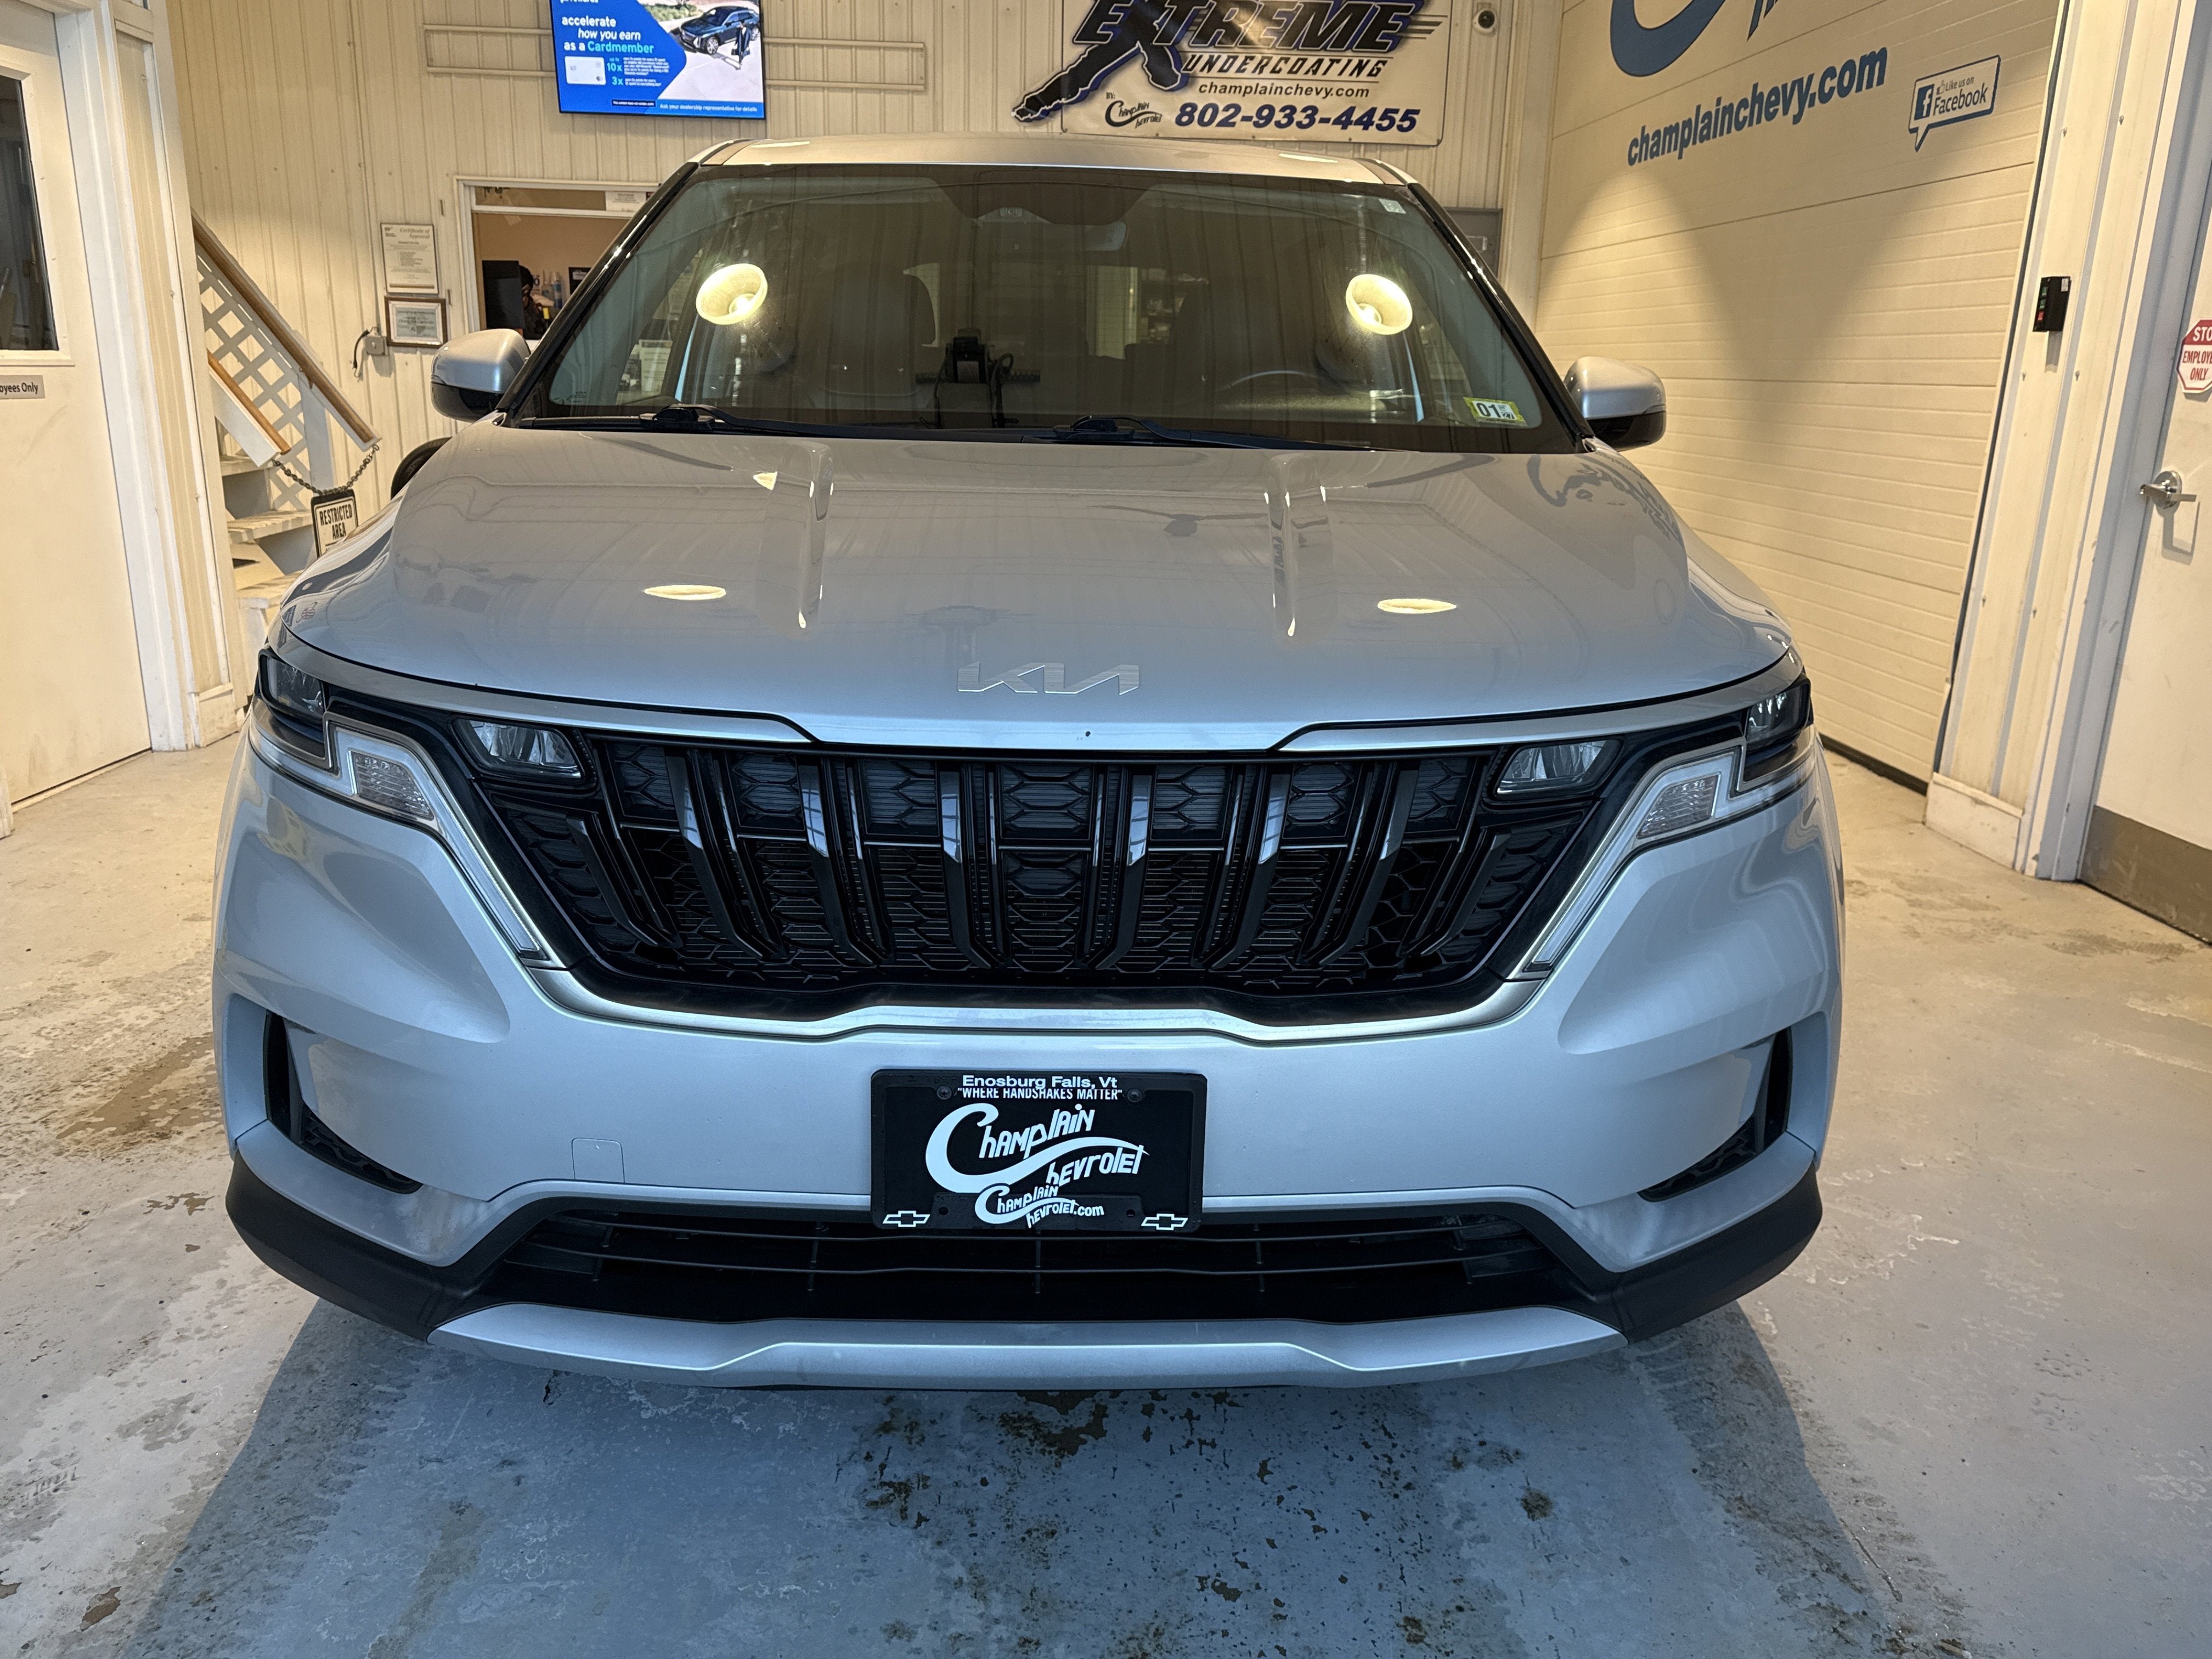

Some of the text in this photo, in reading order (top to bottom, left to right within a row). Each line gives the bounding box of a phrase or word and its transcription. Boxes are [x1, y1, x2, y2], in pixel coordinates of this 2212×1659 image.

[561, 15, 616, 27] accelerate
[578, 28, 641, 41] how you earn
[564, 41, 654, 53] as a Cardmember
[607, 62, 622, 72] 10x
[1181, 54, 1388, 78] UNDERCOATING
[612, 76, 623, 85] 3x
[1945, 76, 1974, 92] Like us on
[1198, 82, 1370, 99] champlainchevy.com
[1628, 47, 1887, 166] champlainchevy.com
[1933, 82, 1988, 116] Facebook
[1175, 102, 1421, 133] 802-933-4455
[2190, 368, 2209, 381] ONLY
[21, 382, 38, 394] Only
[1476, 403, 1501, 418] 01
[319, 504, 352, 526] RESTRICTED
[332, 522, 346, 540] AREA
[957, 662, 1141, 696] KIA
[962, 1075, 1118, 1090] Enosburg Falls, Vt
[957, 1087, 1123, 1100] "WHERE HANDSHAKES MATTER"
